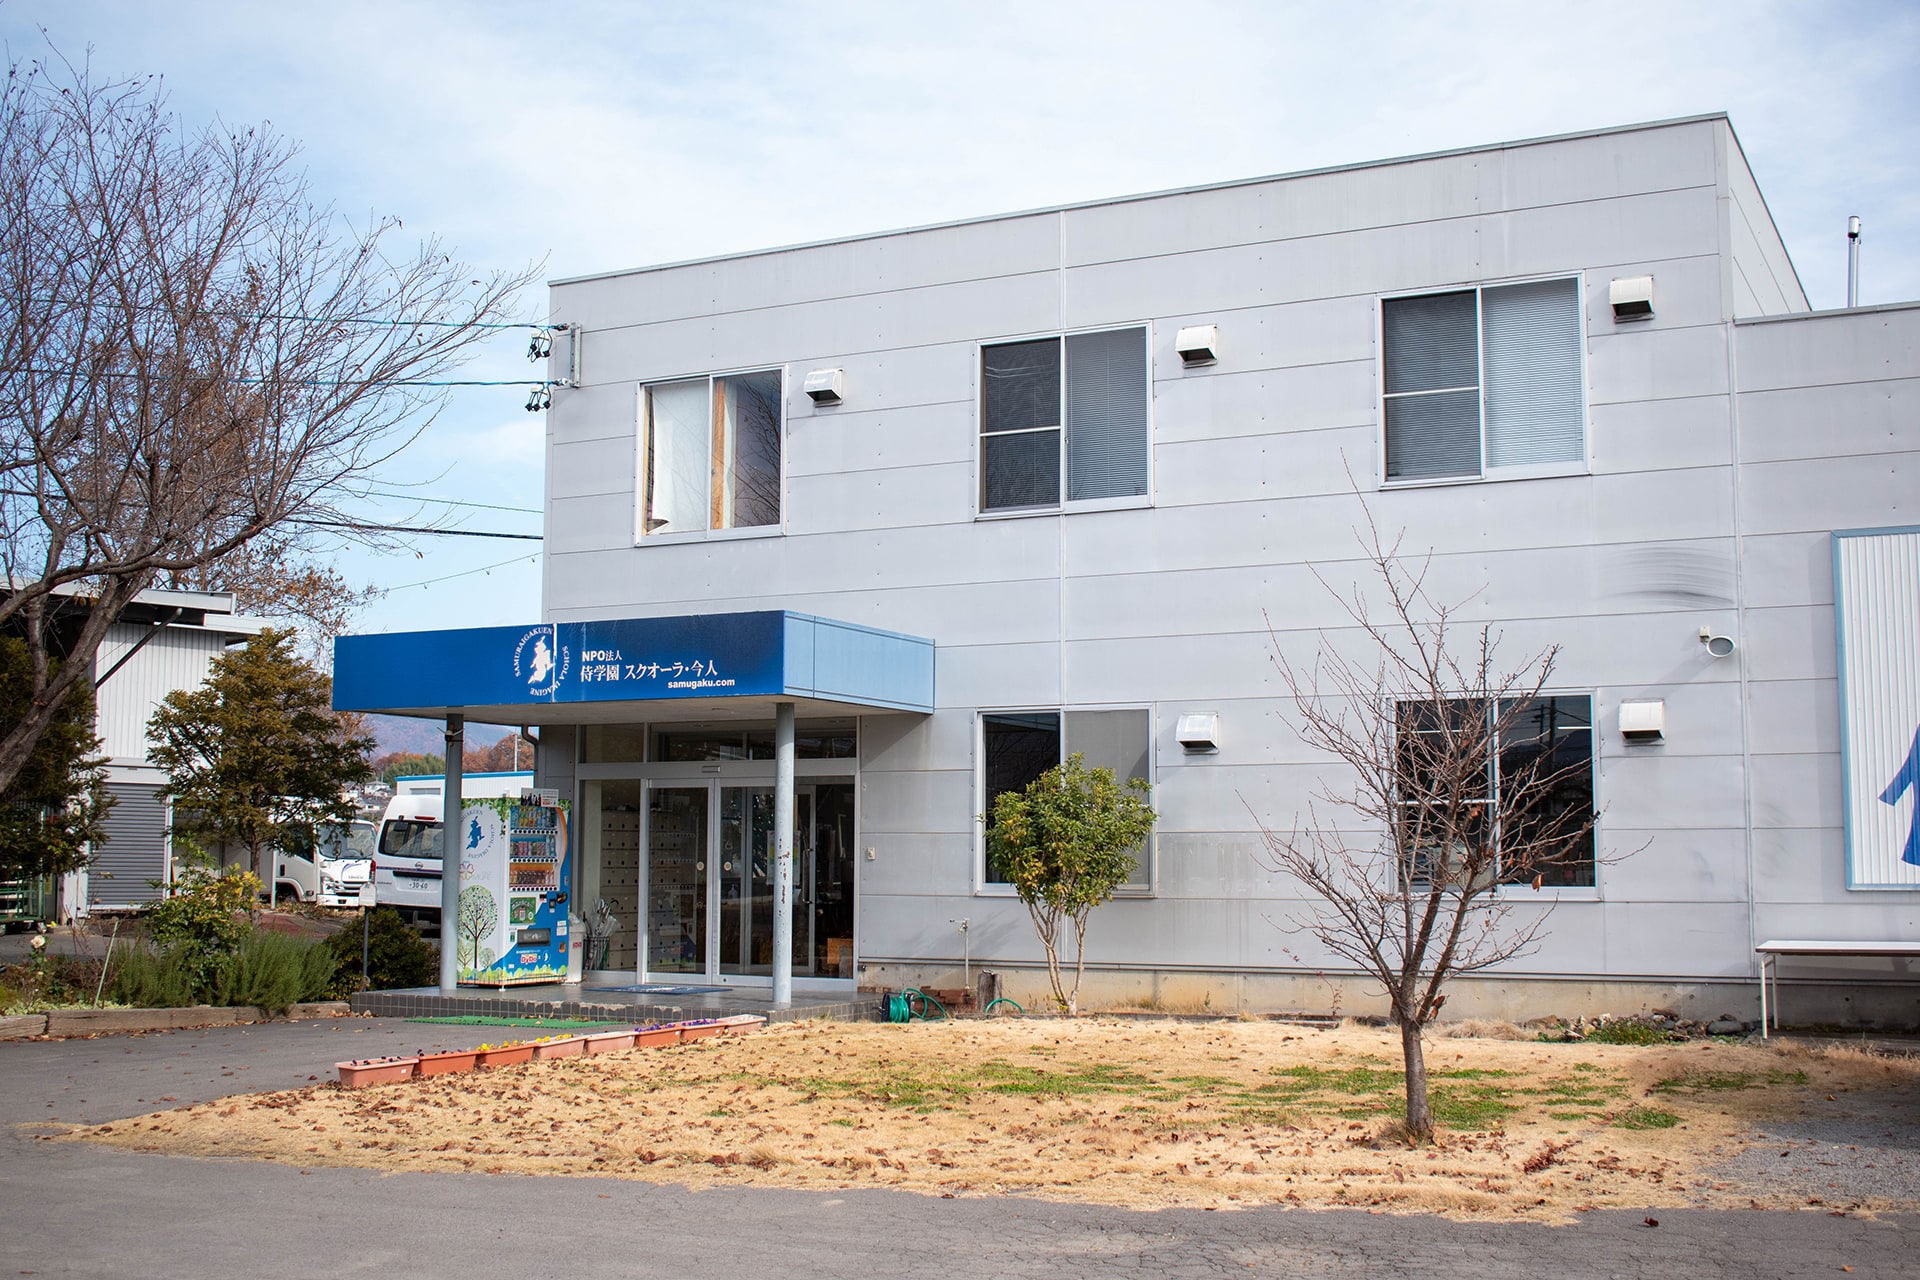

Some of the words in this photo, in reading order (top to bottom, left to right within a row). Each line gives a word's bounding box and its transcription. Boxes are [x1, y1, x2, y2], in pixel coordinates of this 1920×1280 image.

[513, 626, 552, 677] SAMURAIGAKUEN
[581, 650, 622, 662] NPO法人
[559, 645, 570, 680] SCHOLA
[580, 664, 619, 682] 侍学園
[624, 659, 718, 680] スクオーラ・今人
[529, 680, 561, 696] IMAGINE
[667, 678, 735, 690] samugaku.com
